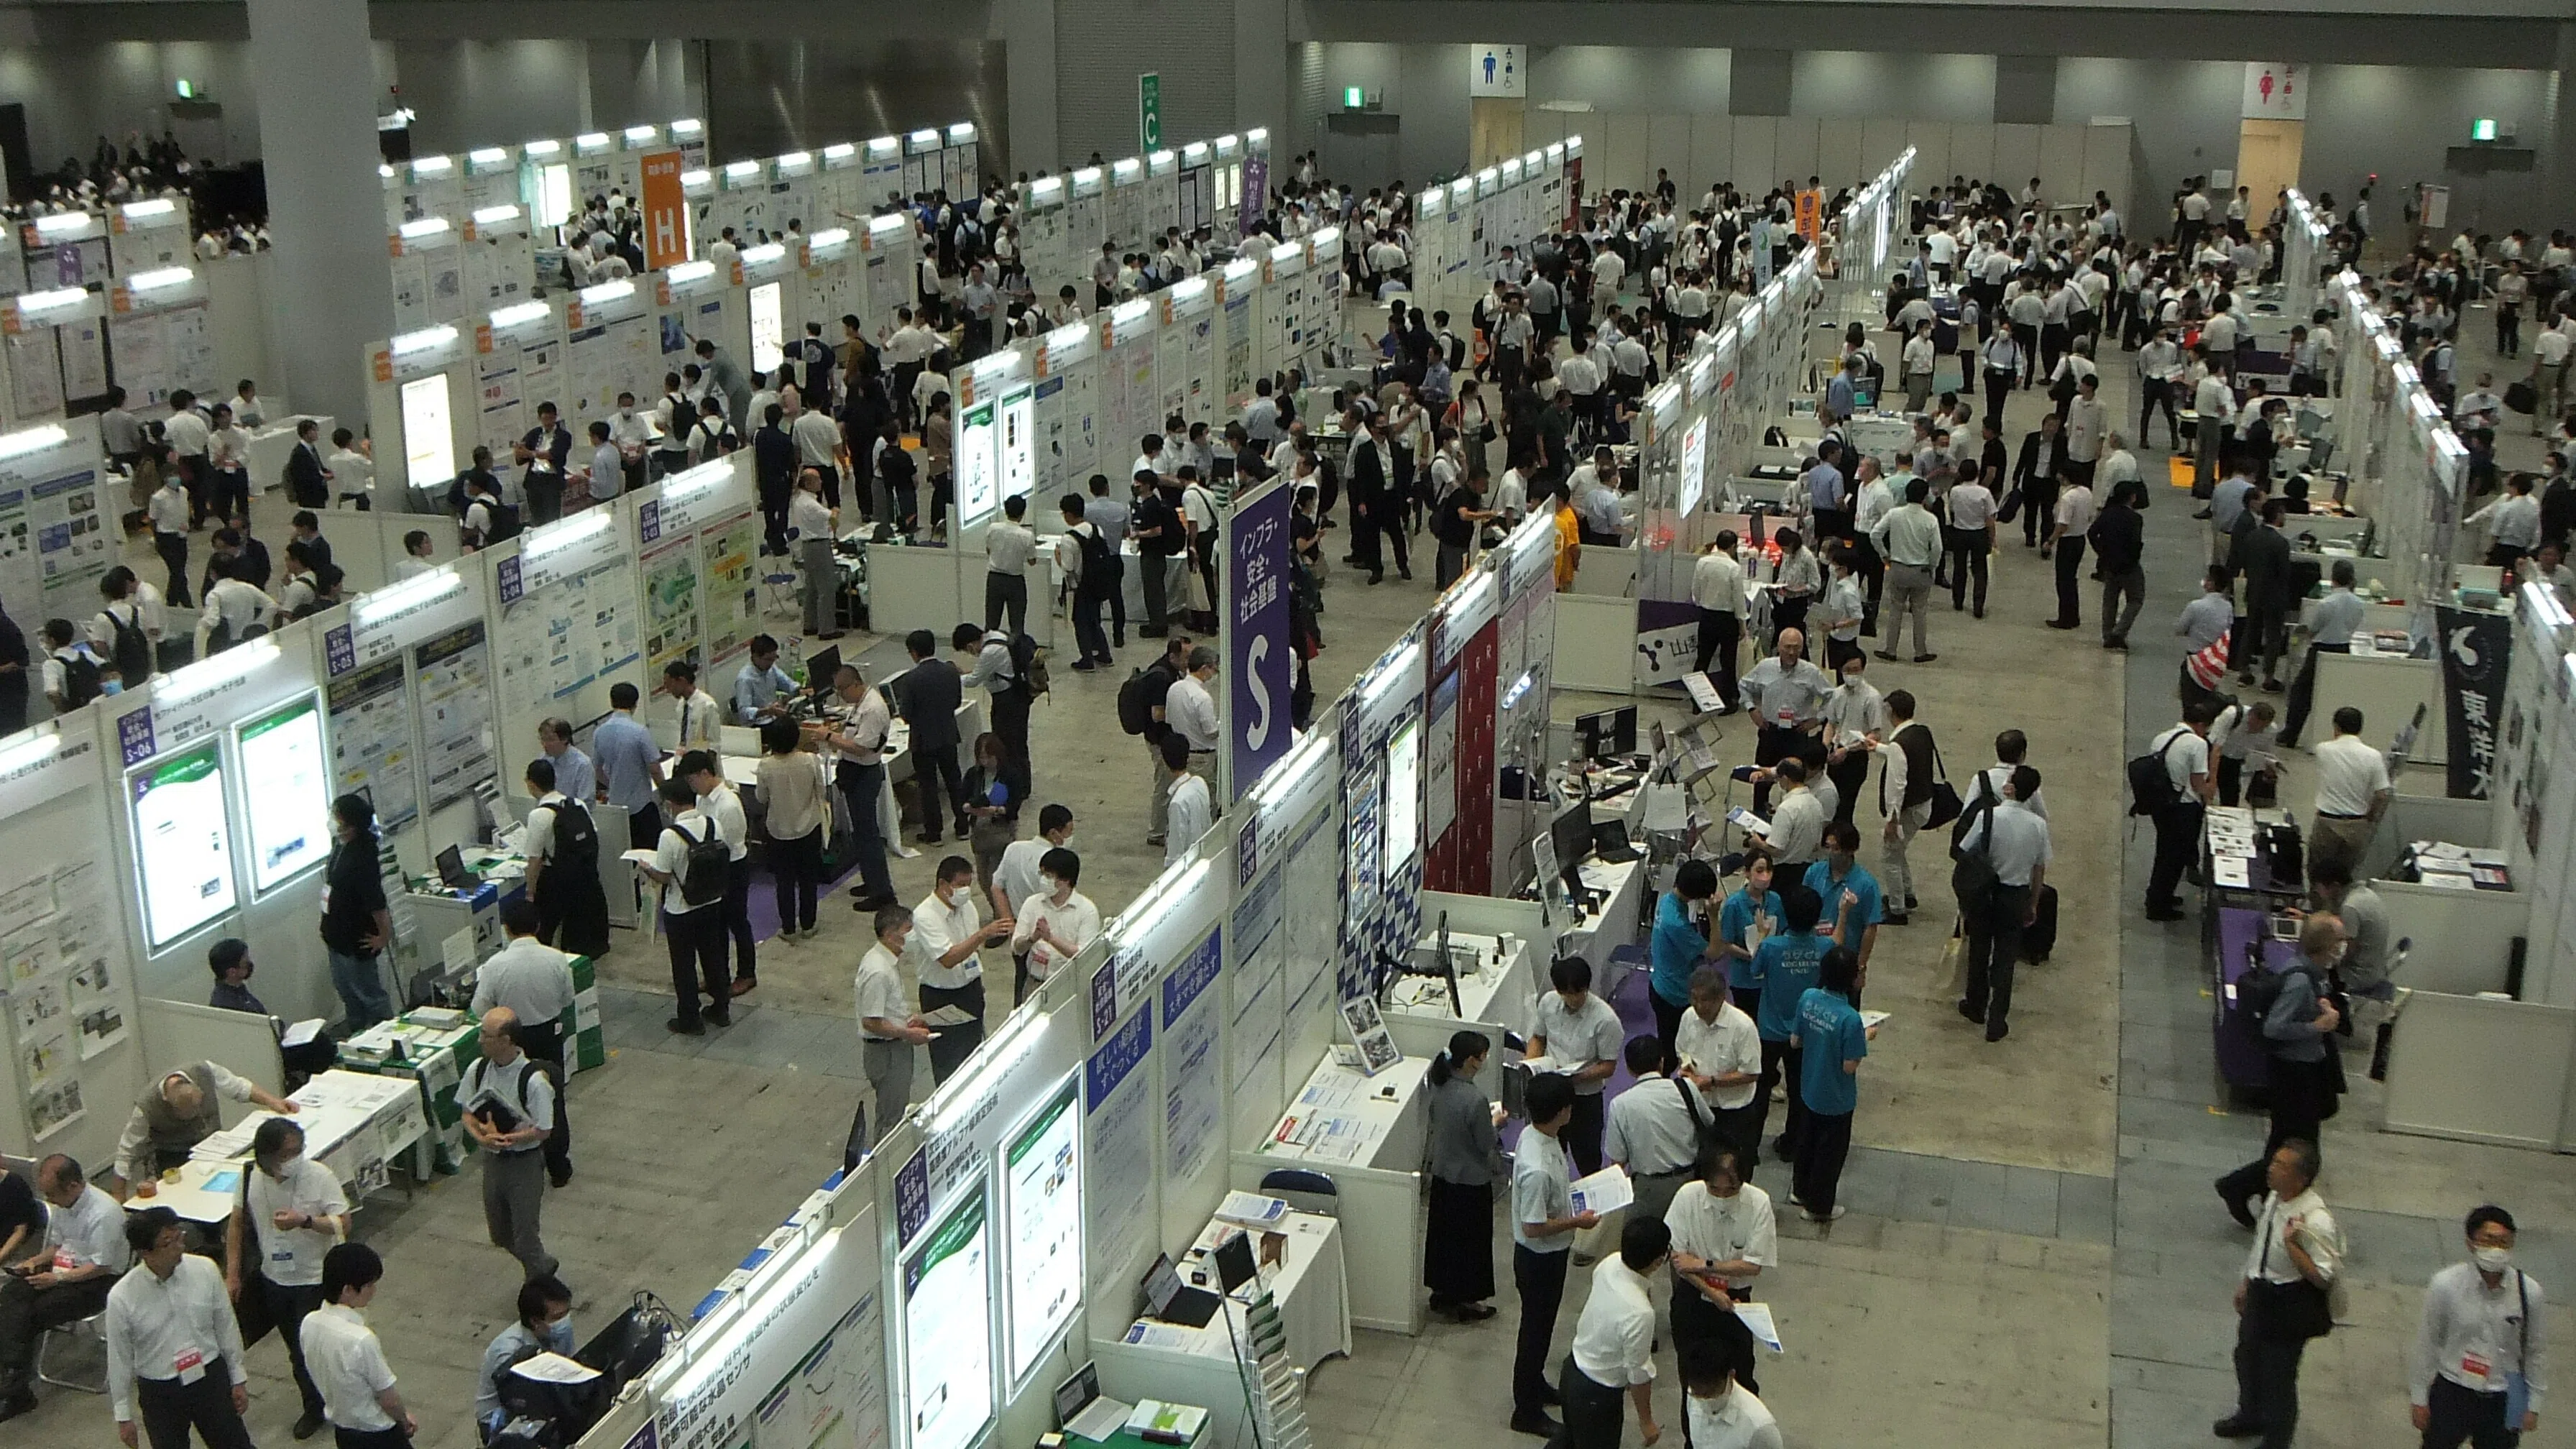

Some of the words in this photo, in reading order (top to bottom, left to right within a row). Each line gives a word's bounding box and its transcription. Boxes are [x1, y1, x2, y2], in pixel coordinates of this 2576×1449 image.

[1146, 113, 1156, 144] C
[655, 208, 676, 255] H
[1240, 575, 1277, 625] 社会基盤
[1246, 635, 1270, 751] S
[126, 742, 152, 762] S-06
[903, 1202, 926, 1241] S-22
